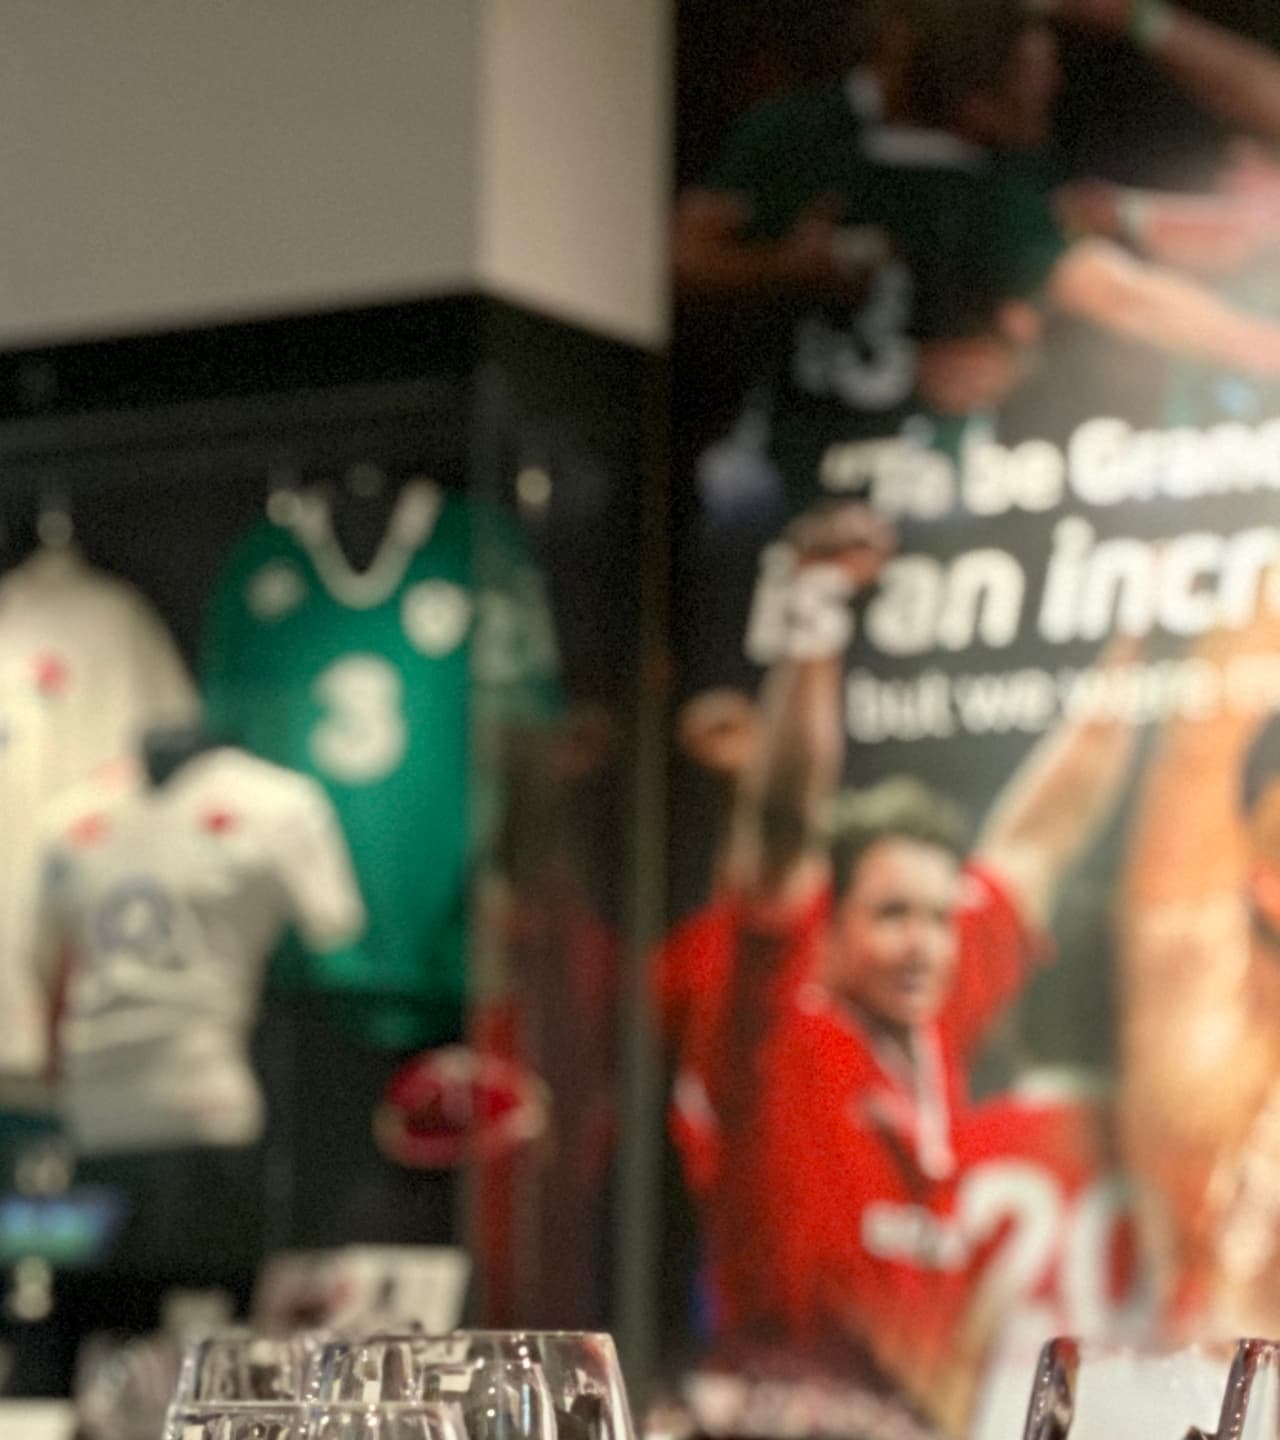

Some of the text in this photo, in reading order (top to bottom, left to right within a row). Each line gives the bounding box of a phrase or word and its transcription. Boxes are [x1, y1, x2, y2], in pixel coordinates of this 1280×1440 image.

[963, 420, 1064, 514] be
[864, 546, 1025, 655] an
[308, 648, 410, 786] 3
[846, 668, 952, 744] but
